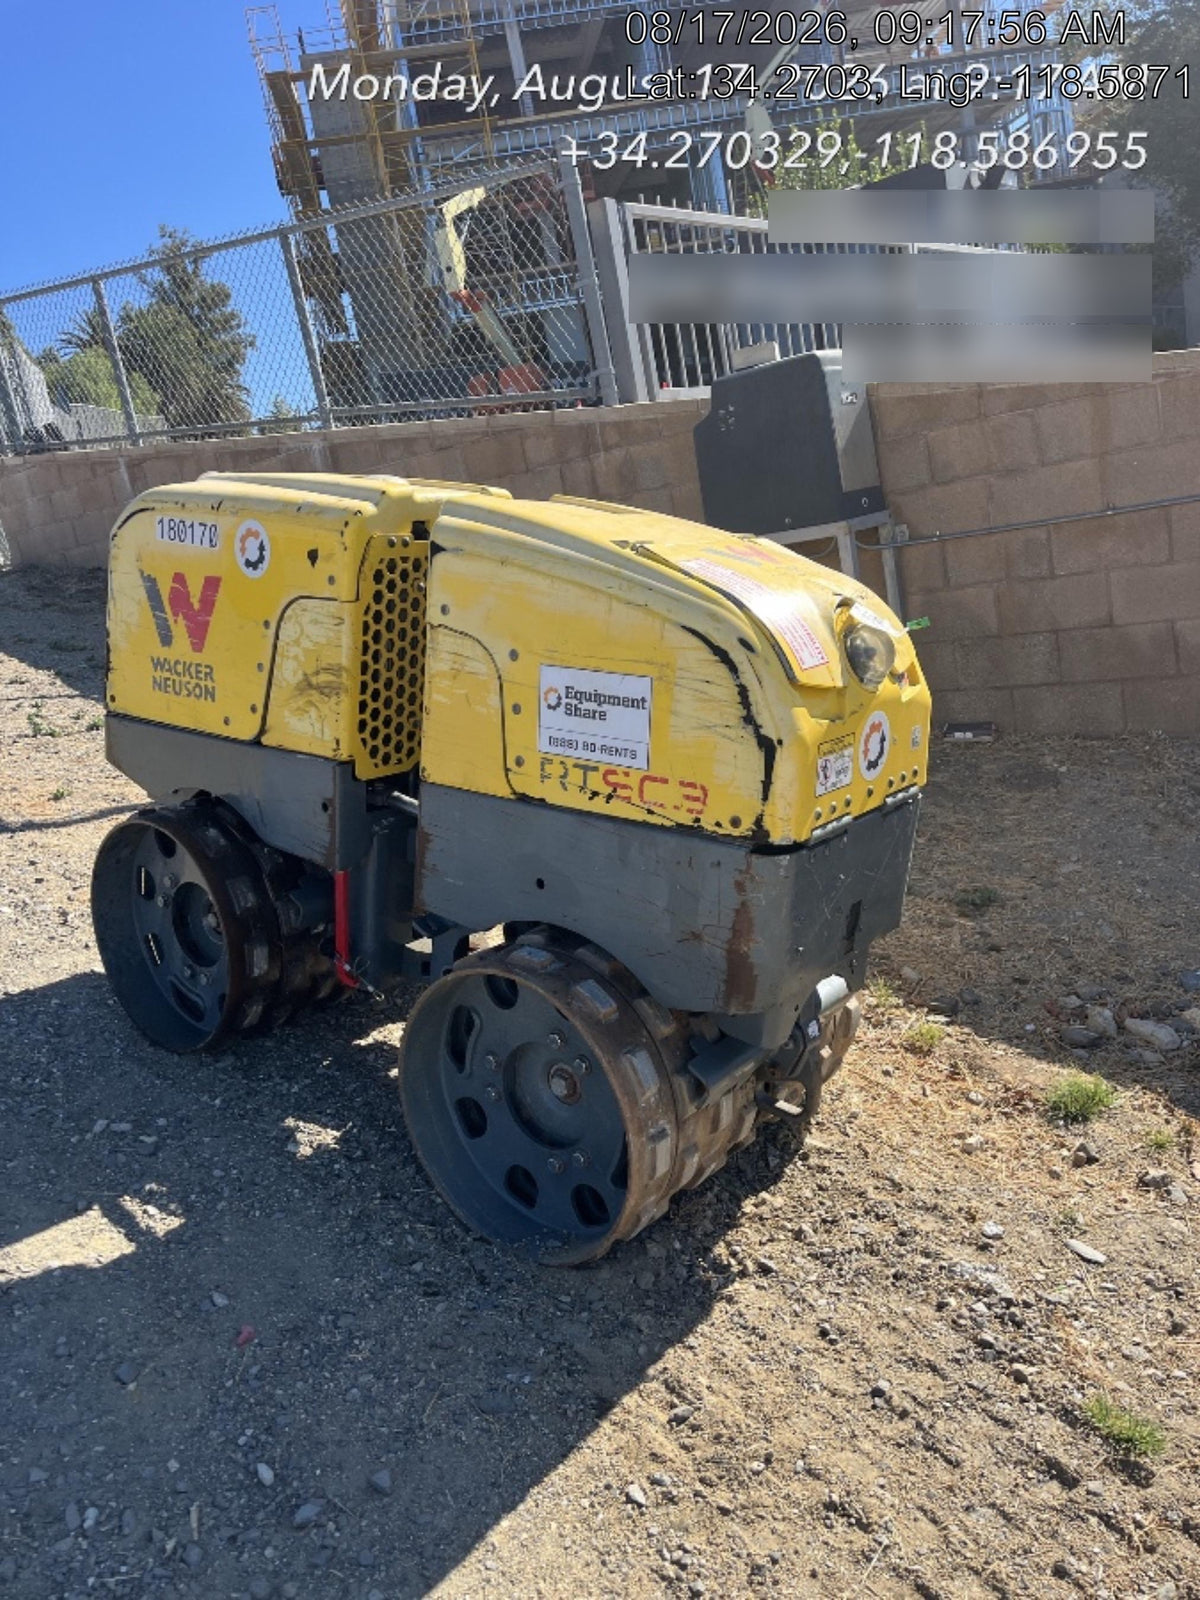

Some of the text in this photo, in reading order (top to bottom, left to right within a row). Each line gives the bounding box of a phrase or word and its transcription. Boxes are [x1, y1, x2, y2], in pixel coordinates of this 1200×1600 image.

[157, 517, 218, 548] 180170
[150, 655, 216, 684] WACKER
[151, 675, 217, 703] NEUSON
[564, 685, 648, 710] Equipment
[564, 702, 608, 721] Share
